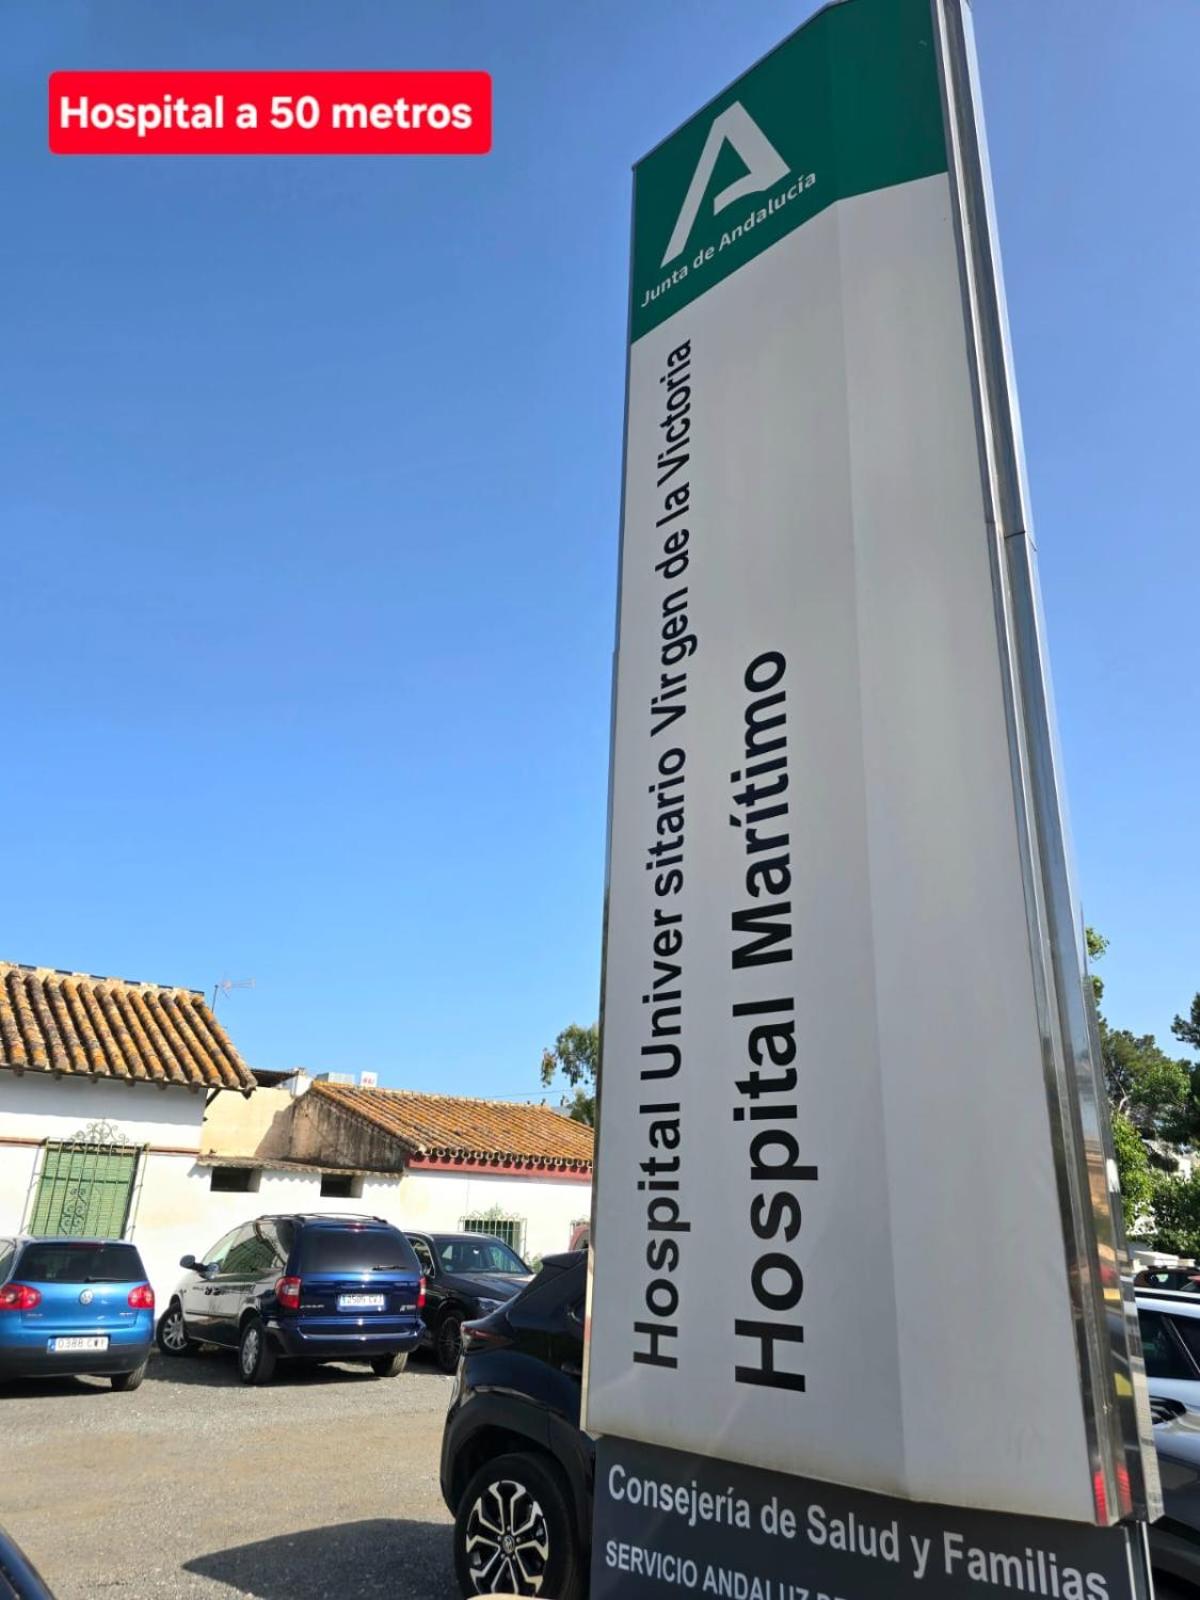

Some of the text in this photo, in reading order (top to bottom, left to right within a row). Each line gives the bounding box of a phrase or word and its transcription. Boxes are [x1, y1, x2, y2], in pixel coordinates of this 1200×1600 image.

[641, 172, 817, 308] Junta de Andalucía
[656, 338, 692, 488] Victoria
[654, 528, 690, 580] de
[655, 481, 690, 528] la
[650, 586, 698, 738] Virgen
[729, 650, 819, 1393] Hospital Marítimo
[632, 1102, 691, 1370] Hospital
[605, 1540, 698, 1588] SERVICIO
[608, 1464, 1110, 1600] Consejería de Salud y Familias
